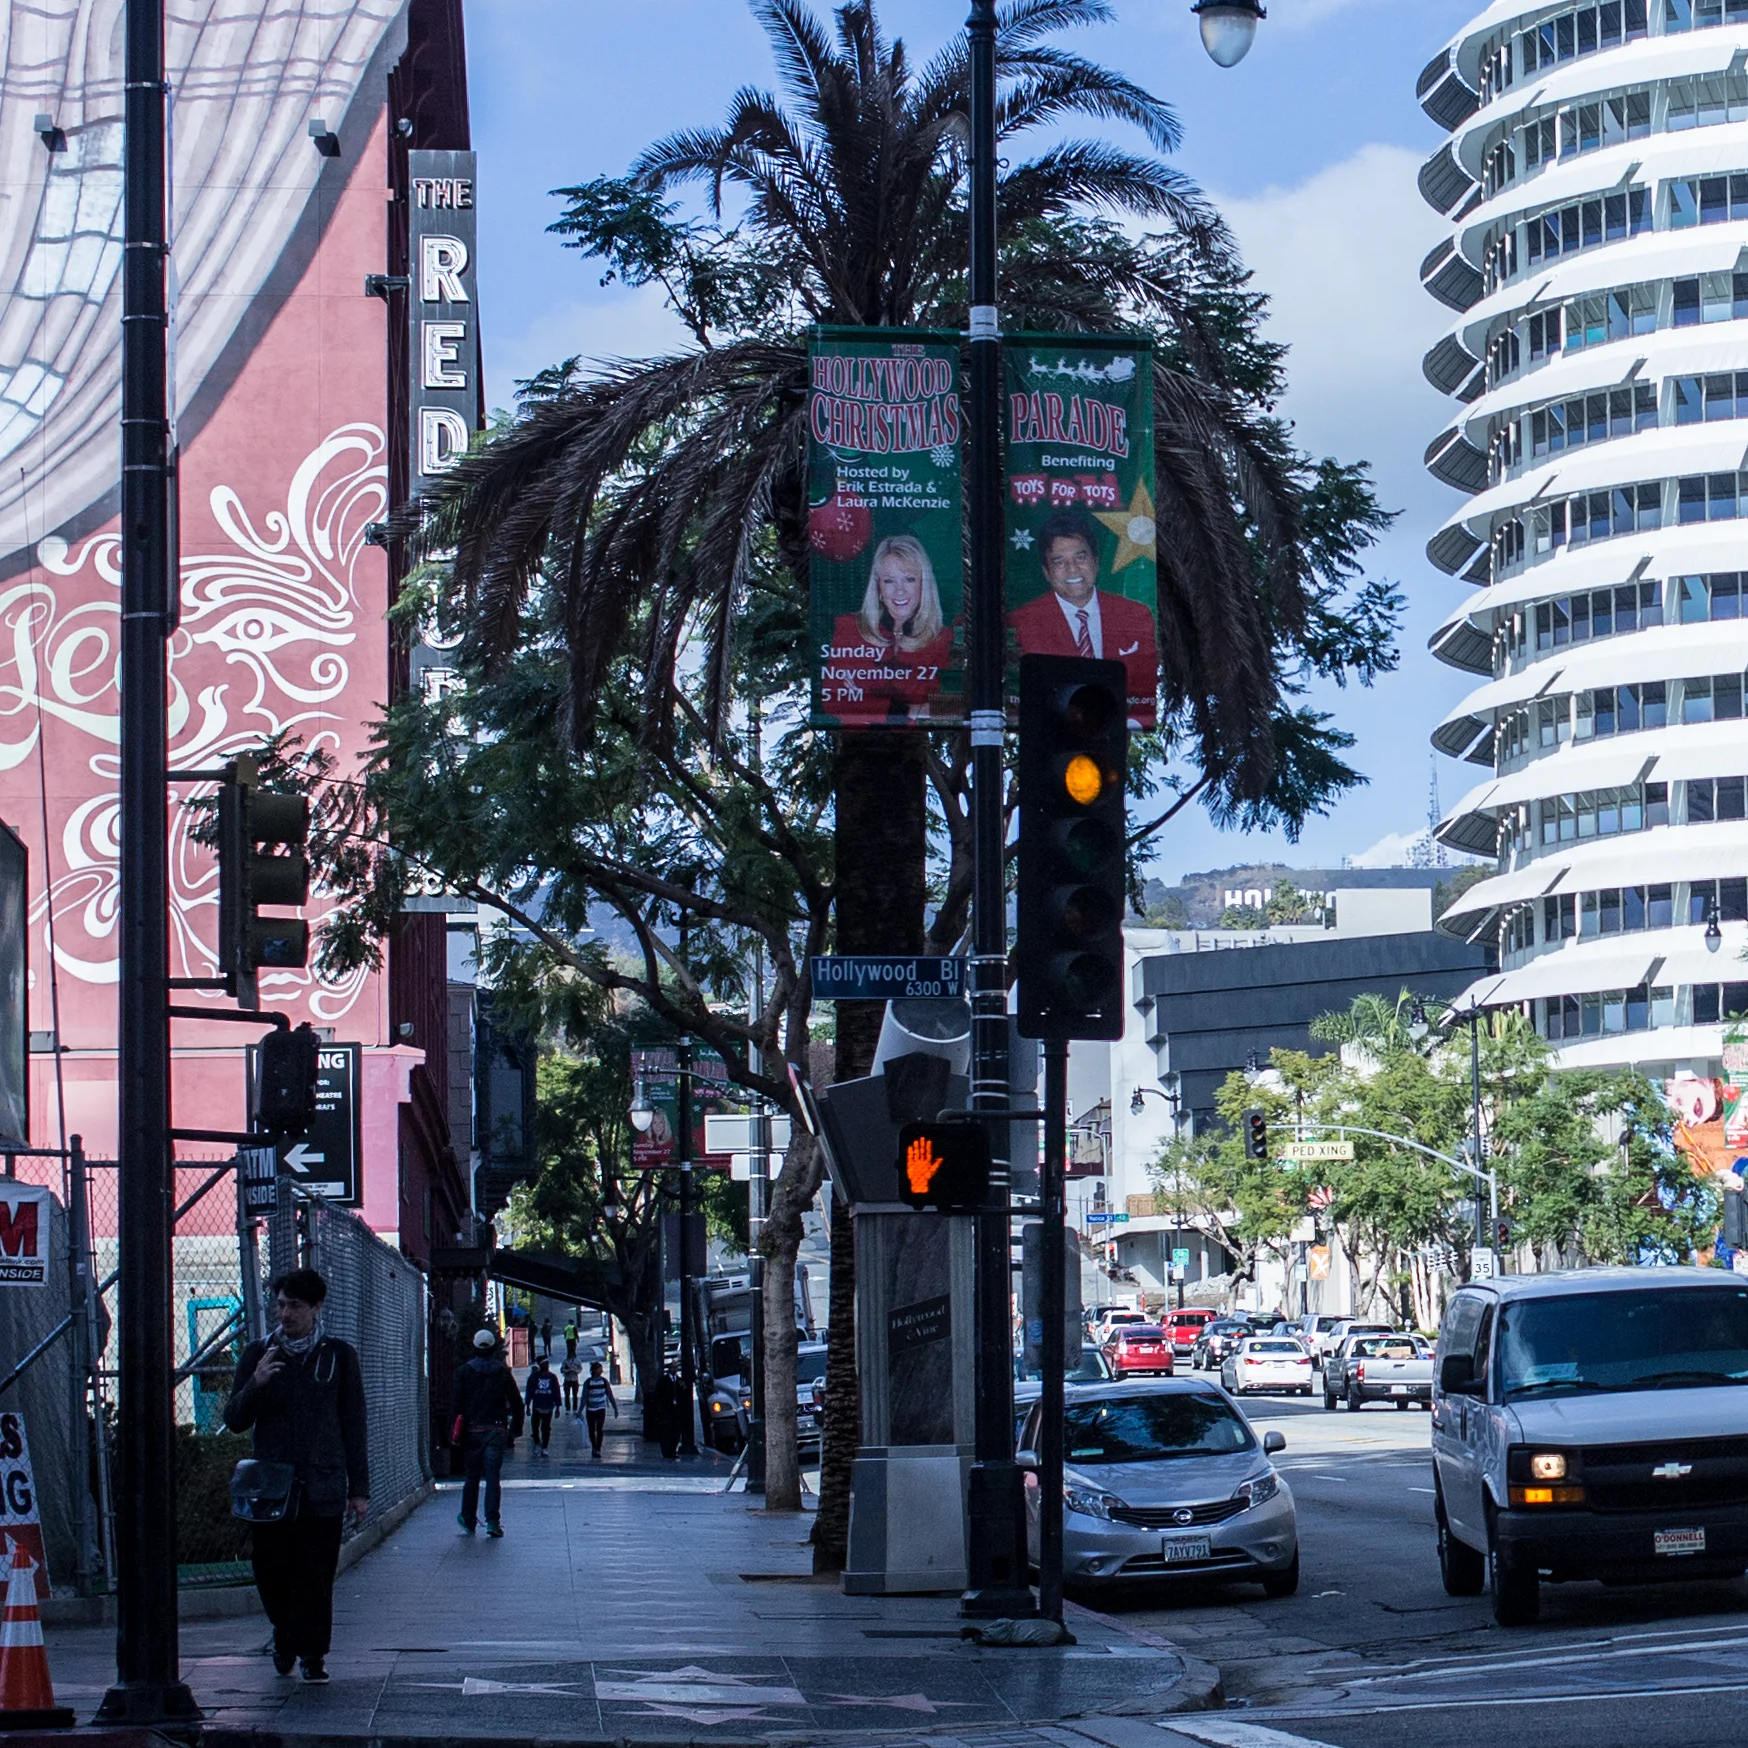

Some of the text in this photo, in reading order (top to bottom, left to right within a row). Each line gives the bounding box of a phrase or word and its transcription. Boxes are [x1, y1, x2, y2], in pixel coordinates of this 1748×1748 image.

[413, 178, 473, 209] THE
[812, 356, 952, 402] HOLLYWOOD
[810, 392, 959, 454] CHRISTMAS
[1010, 390, 1129, 458] PARADE
[1041, 455, 1115, 471] Benefiting
[836, 466, 910, 480] Hosted by
[837, 481, 937, 493] Erik Estrada &
[1014, 479, 1115, 501] TOYS FOR TOTS
[837, 496, 951, 508] Laura McKenzie
[820, 644, 886, 662] Sunday
[820, 666, 938, 680] November 27
[821, 688, 864, 702] 5 PM
[817, 960, 959, 987] Hollywood Bl
[905, 981, 958, 996] 6300 W
[1292, 1145, 1347, 1156] PED XING
[1475, 1264, 1489, 1273] 35
[1655, 1533, 1703, 1543] O'DONNELL
